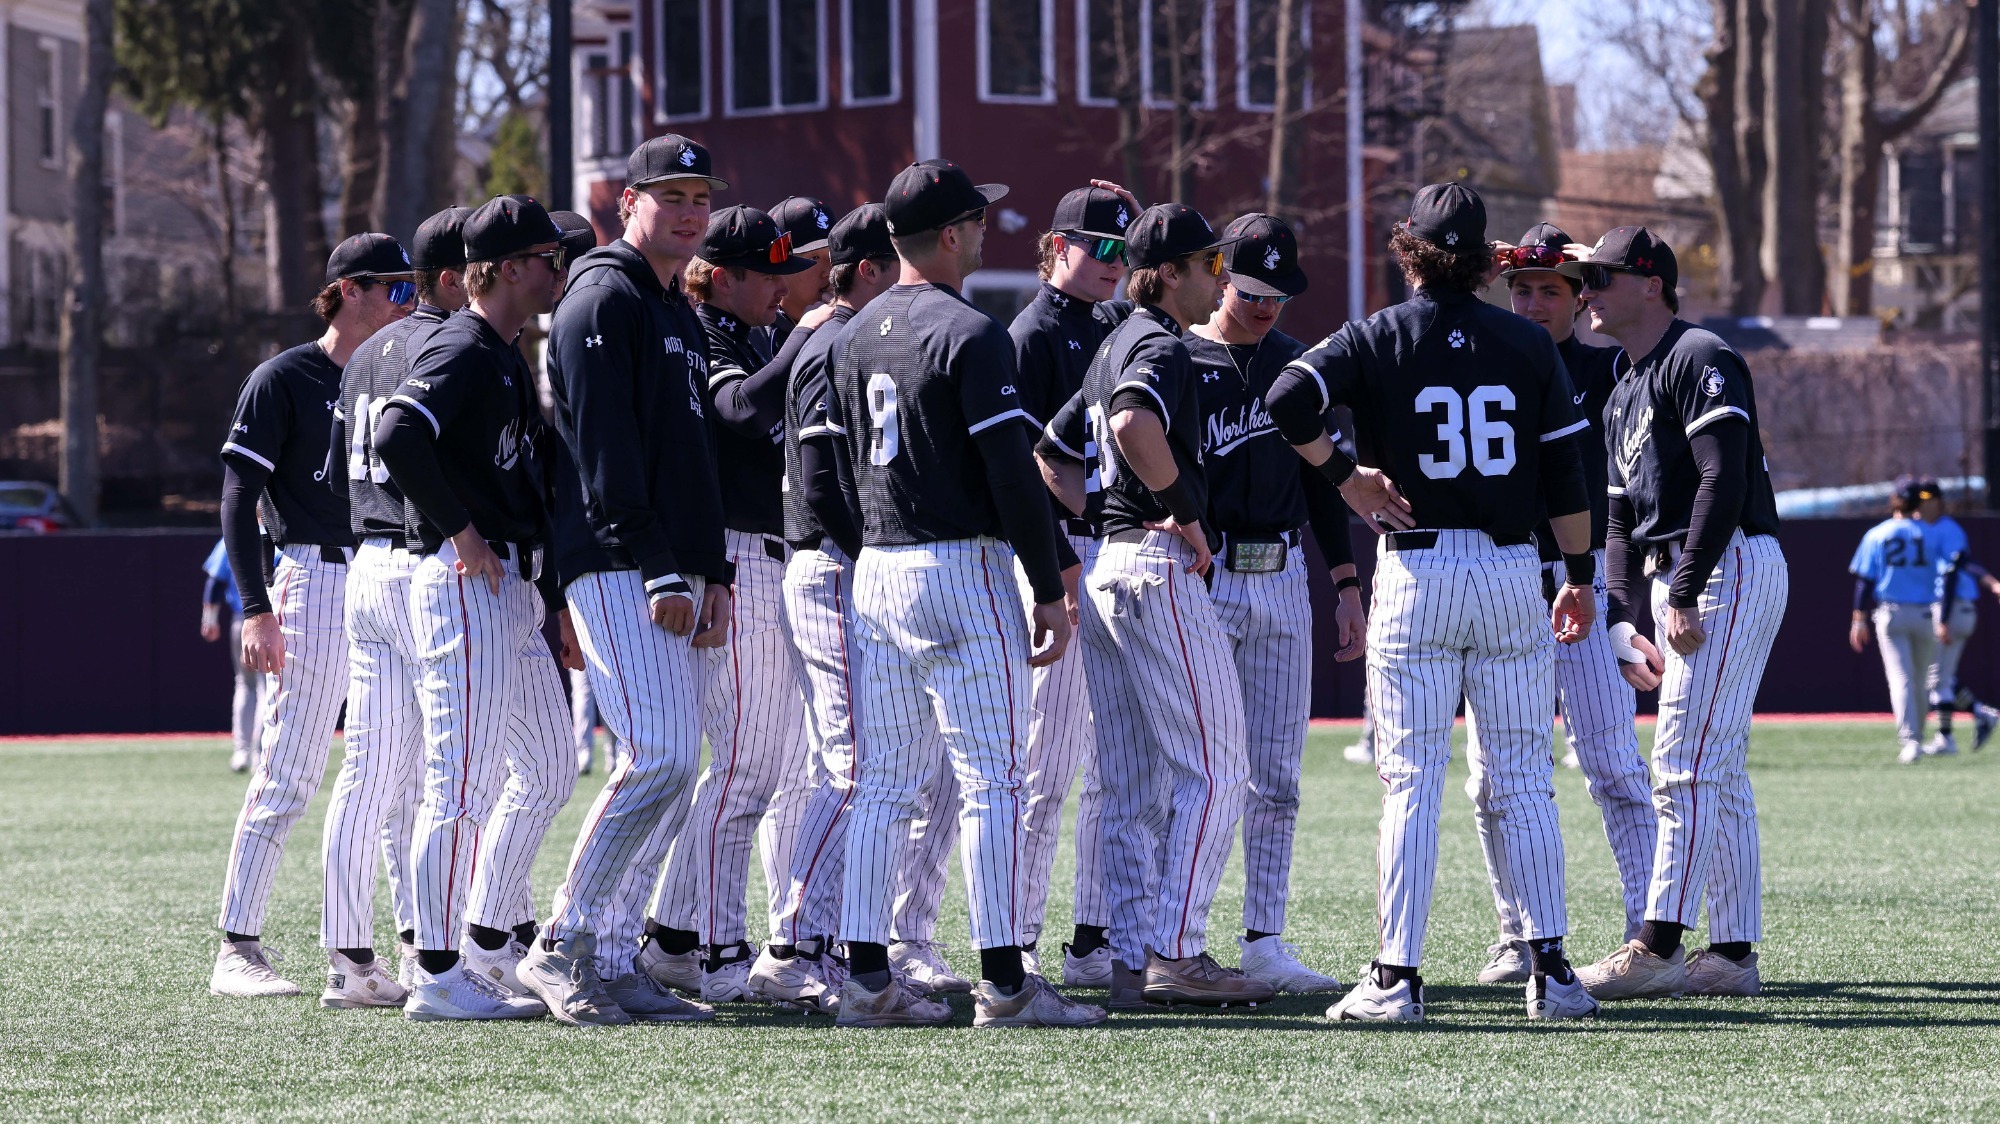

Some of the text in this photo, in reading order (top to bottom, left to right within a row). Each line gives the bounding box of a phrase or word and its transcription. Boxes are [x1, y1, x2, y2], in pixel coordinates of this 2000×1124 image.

[406, 379, 431, 392] CAA
[1000, 384, 1017, 396] CA
[866, 373, 899, 466] 9
[1414, 384, 1517, 480] 36
[1883, 537, 1929, 569] 21
